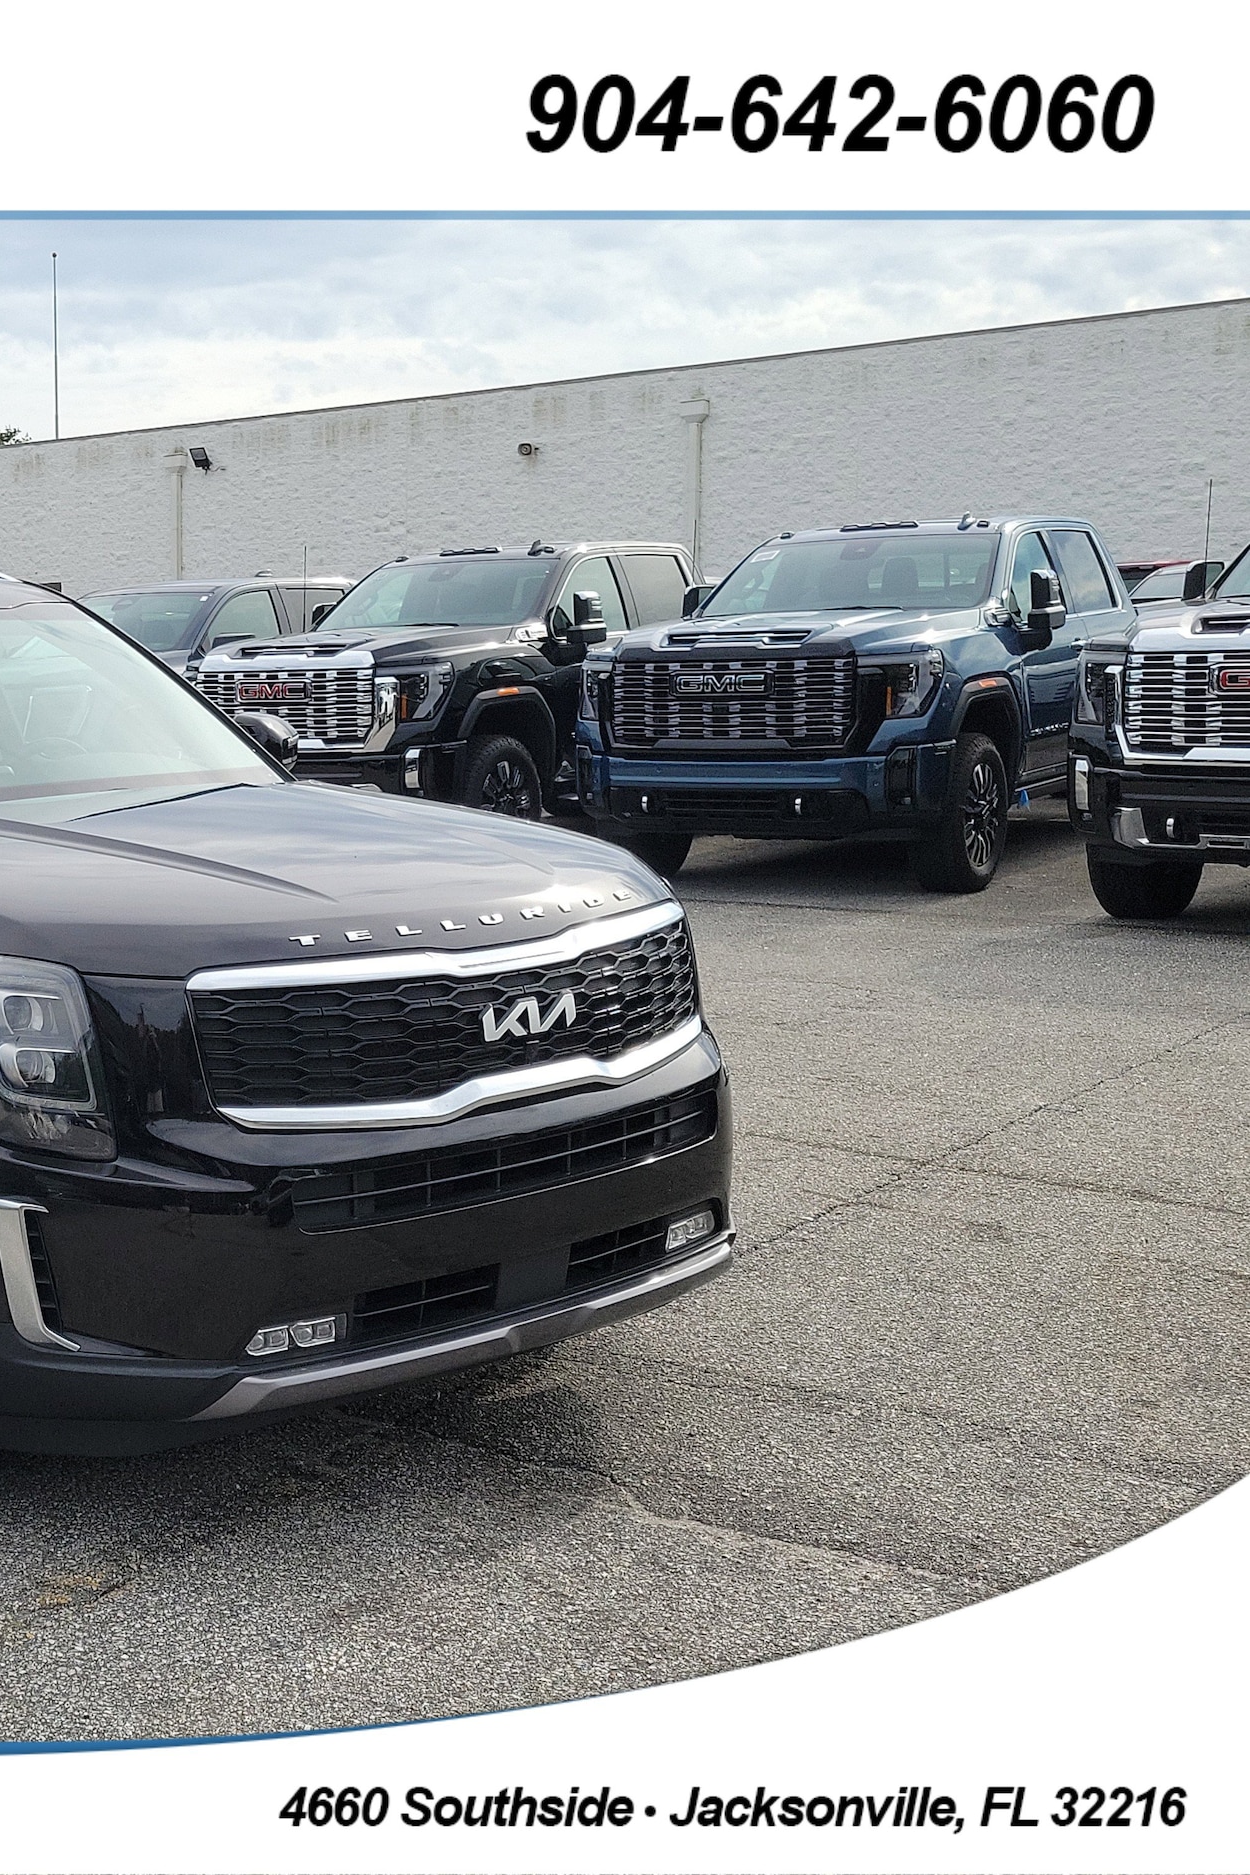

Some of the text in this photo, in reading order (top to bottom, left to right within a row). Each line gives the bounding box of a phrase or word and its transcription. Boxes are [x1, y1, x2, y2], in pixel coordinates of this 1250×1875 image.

[239, 682, 306, 700] GMC
[676, 674, 766, 693] GMC
[288, 887, 633, 948] TELLURIDE
